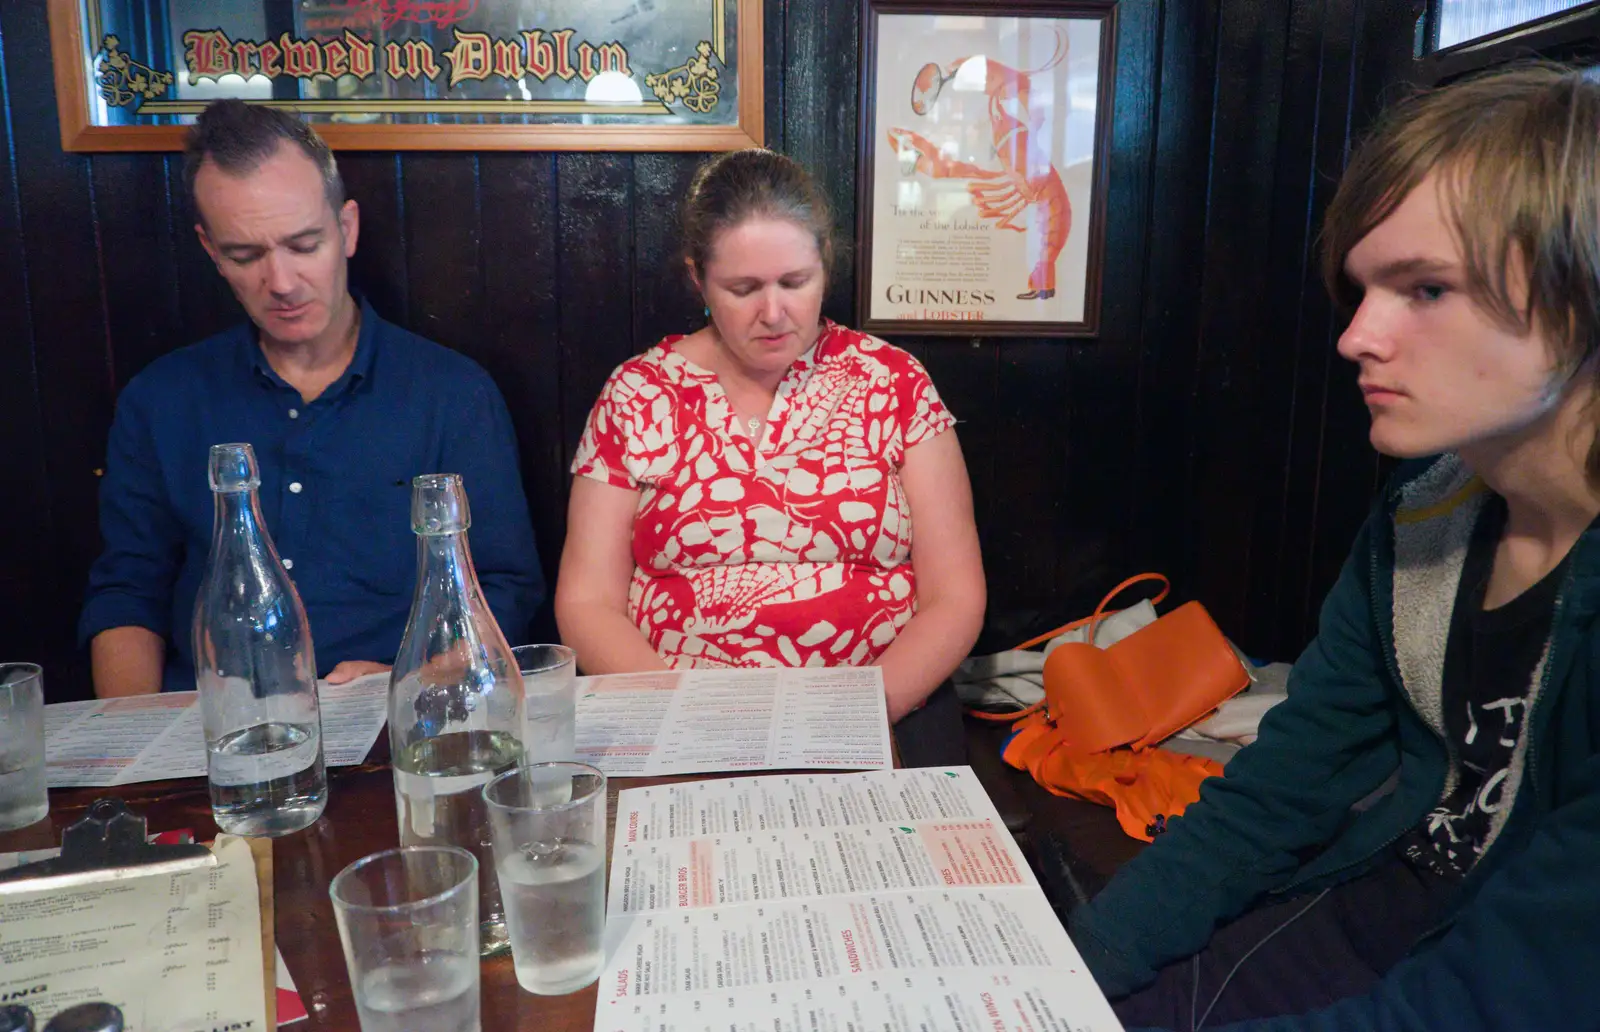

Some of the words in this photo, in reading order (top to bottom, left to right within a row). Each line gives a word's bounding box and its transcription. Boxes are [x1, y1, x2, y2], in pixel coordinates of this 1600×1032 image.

[183, 26, 377, 86] Brewed
[383, 37, 442, 82] in
[443, 25, 633, 90] Dublin
[919, 219, 931, 230] of
[934, 218, 951, 231] the
[953, 218, 990, 232] Lobster
[885, 283, 996, 305] GUINNESS
[923, 308, 984, 321] LOBSTER
[628, 810, 638, 828] COURSE
[627, 829, 637, 842] MAIN
[677, 866, 687, 882] BROS
[939, 868, 956, 885] SIDES
[677, 882, 688, 907] BURGER
[840, 928, 863, 973] SANDWICHES
[615, 968, 629, 997] SALADS
[978, 990, 1001, 1018] WINGS
